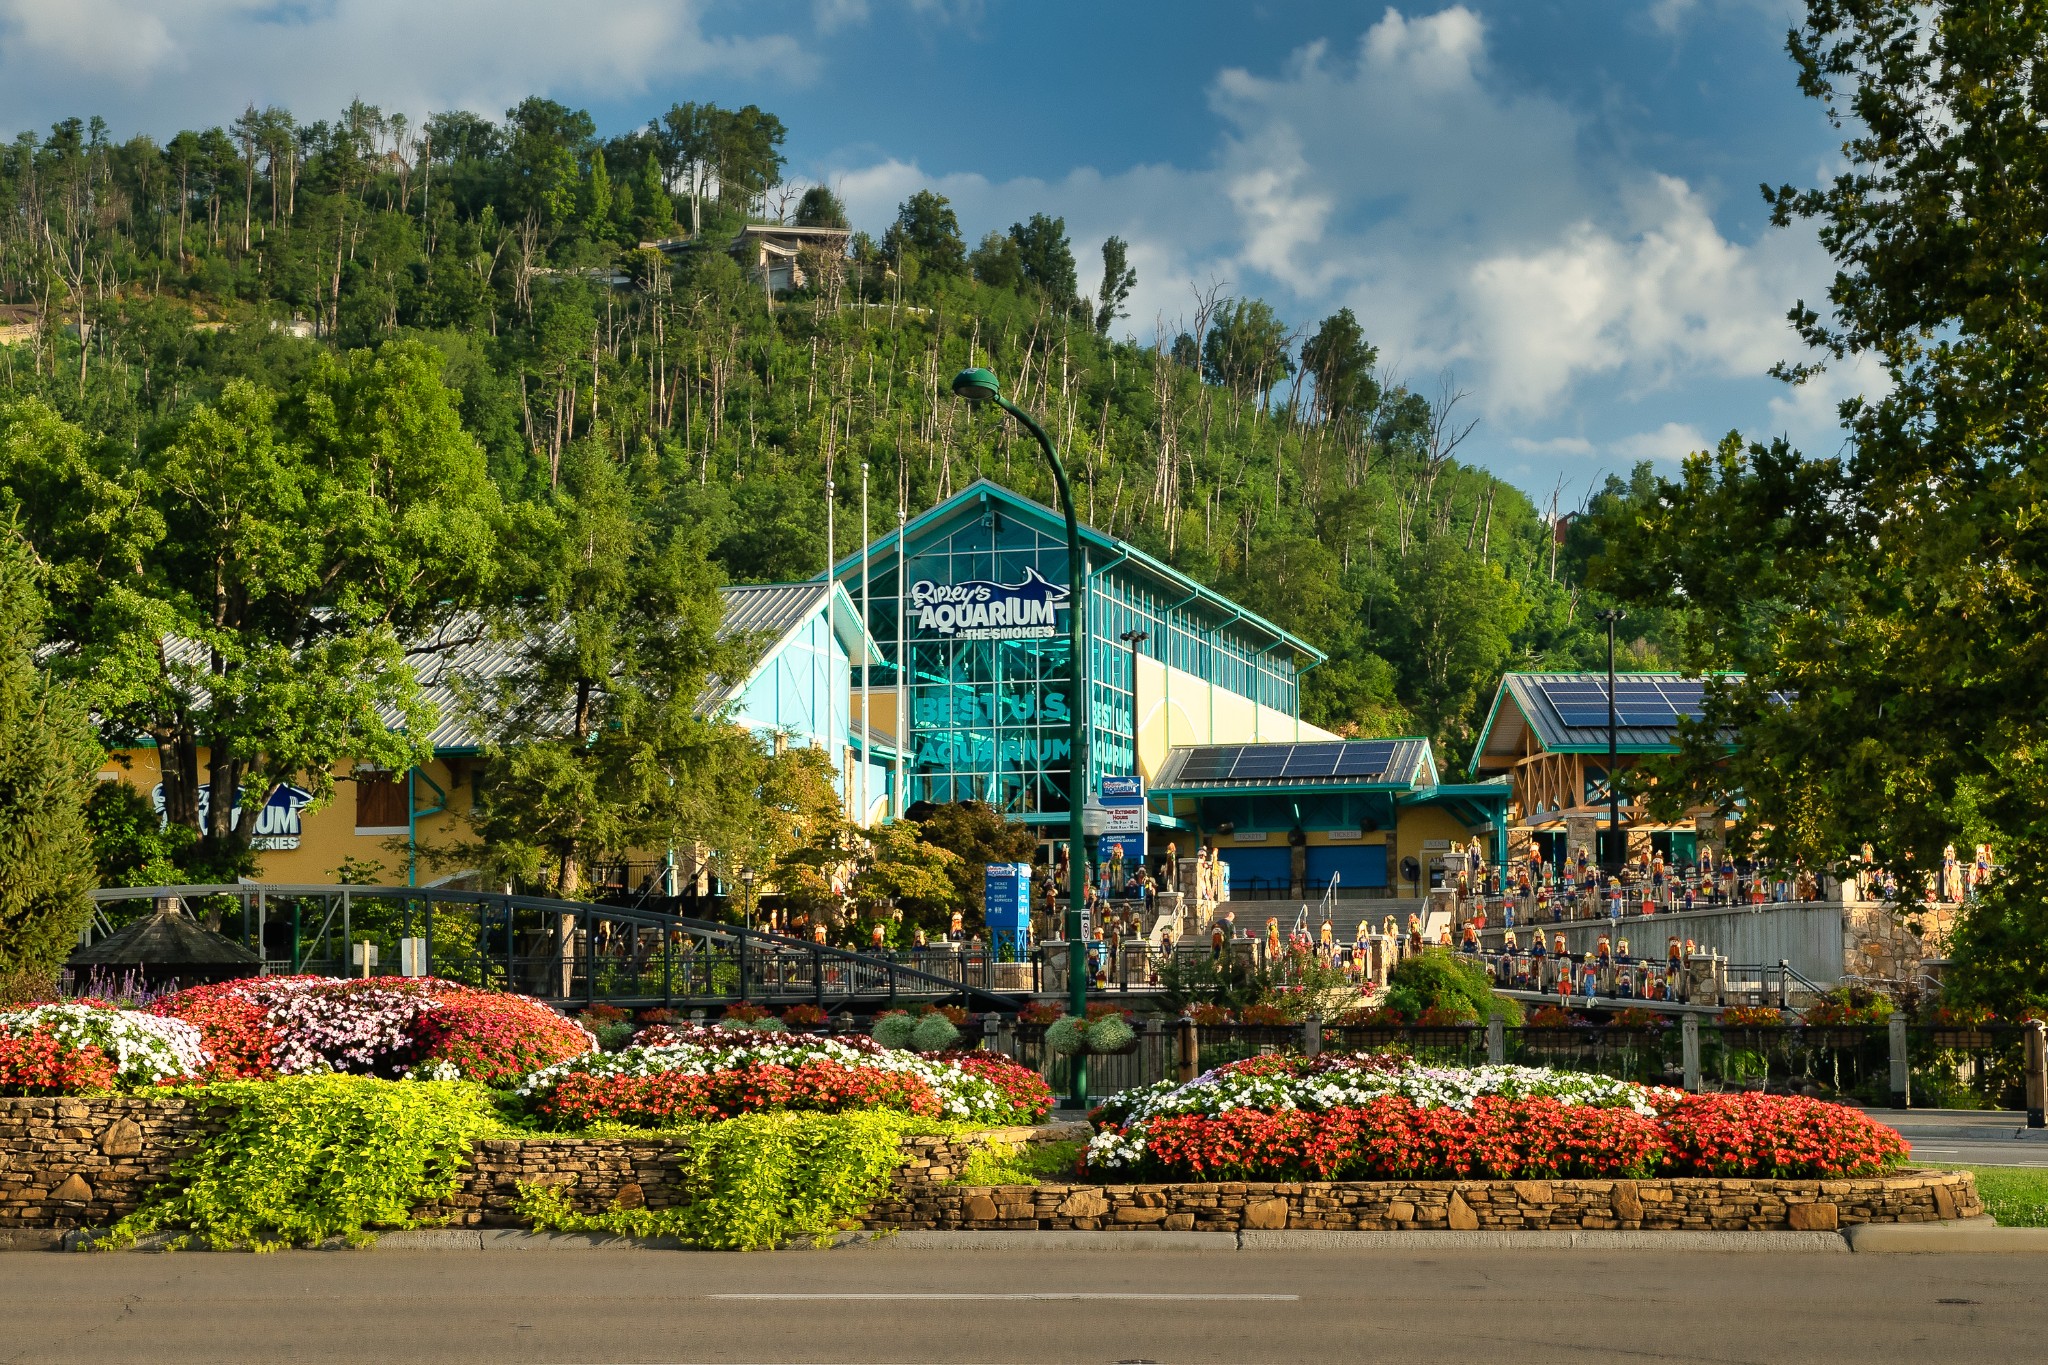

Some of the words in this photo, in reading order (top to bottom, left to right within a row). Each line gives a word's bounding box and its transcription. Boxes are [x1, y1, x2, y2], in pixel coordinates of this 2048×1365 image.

[918, 597, 1055, 634] AQUARIUM
[966, 627, 990, 640] THE
[991, 625, 1056, 640] SMOKIES
[916, 695, 994, 722] BEST
[1093, 701, 1112, 730] BEST
[918, 738, 1071, 764] AQUARIUM
